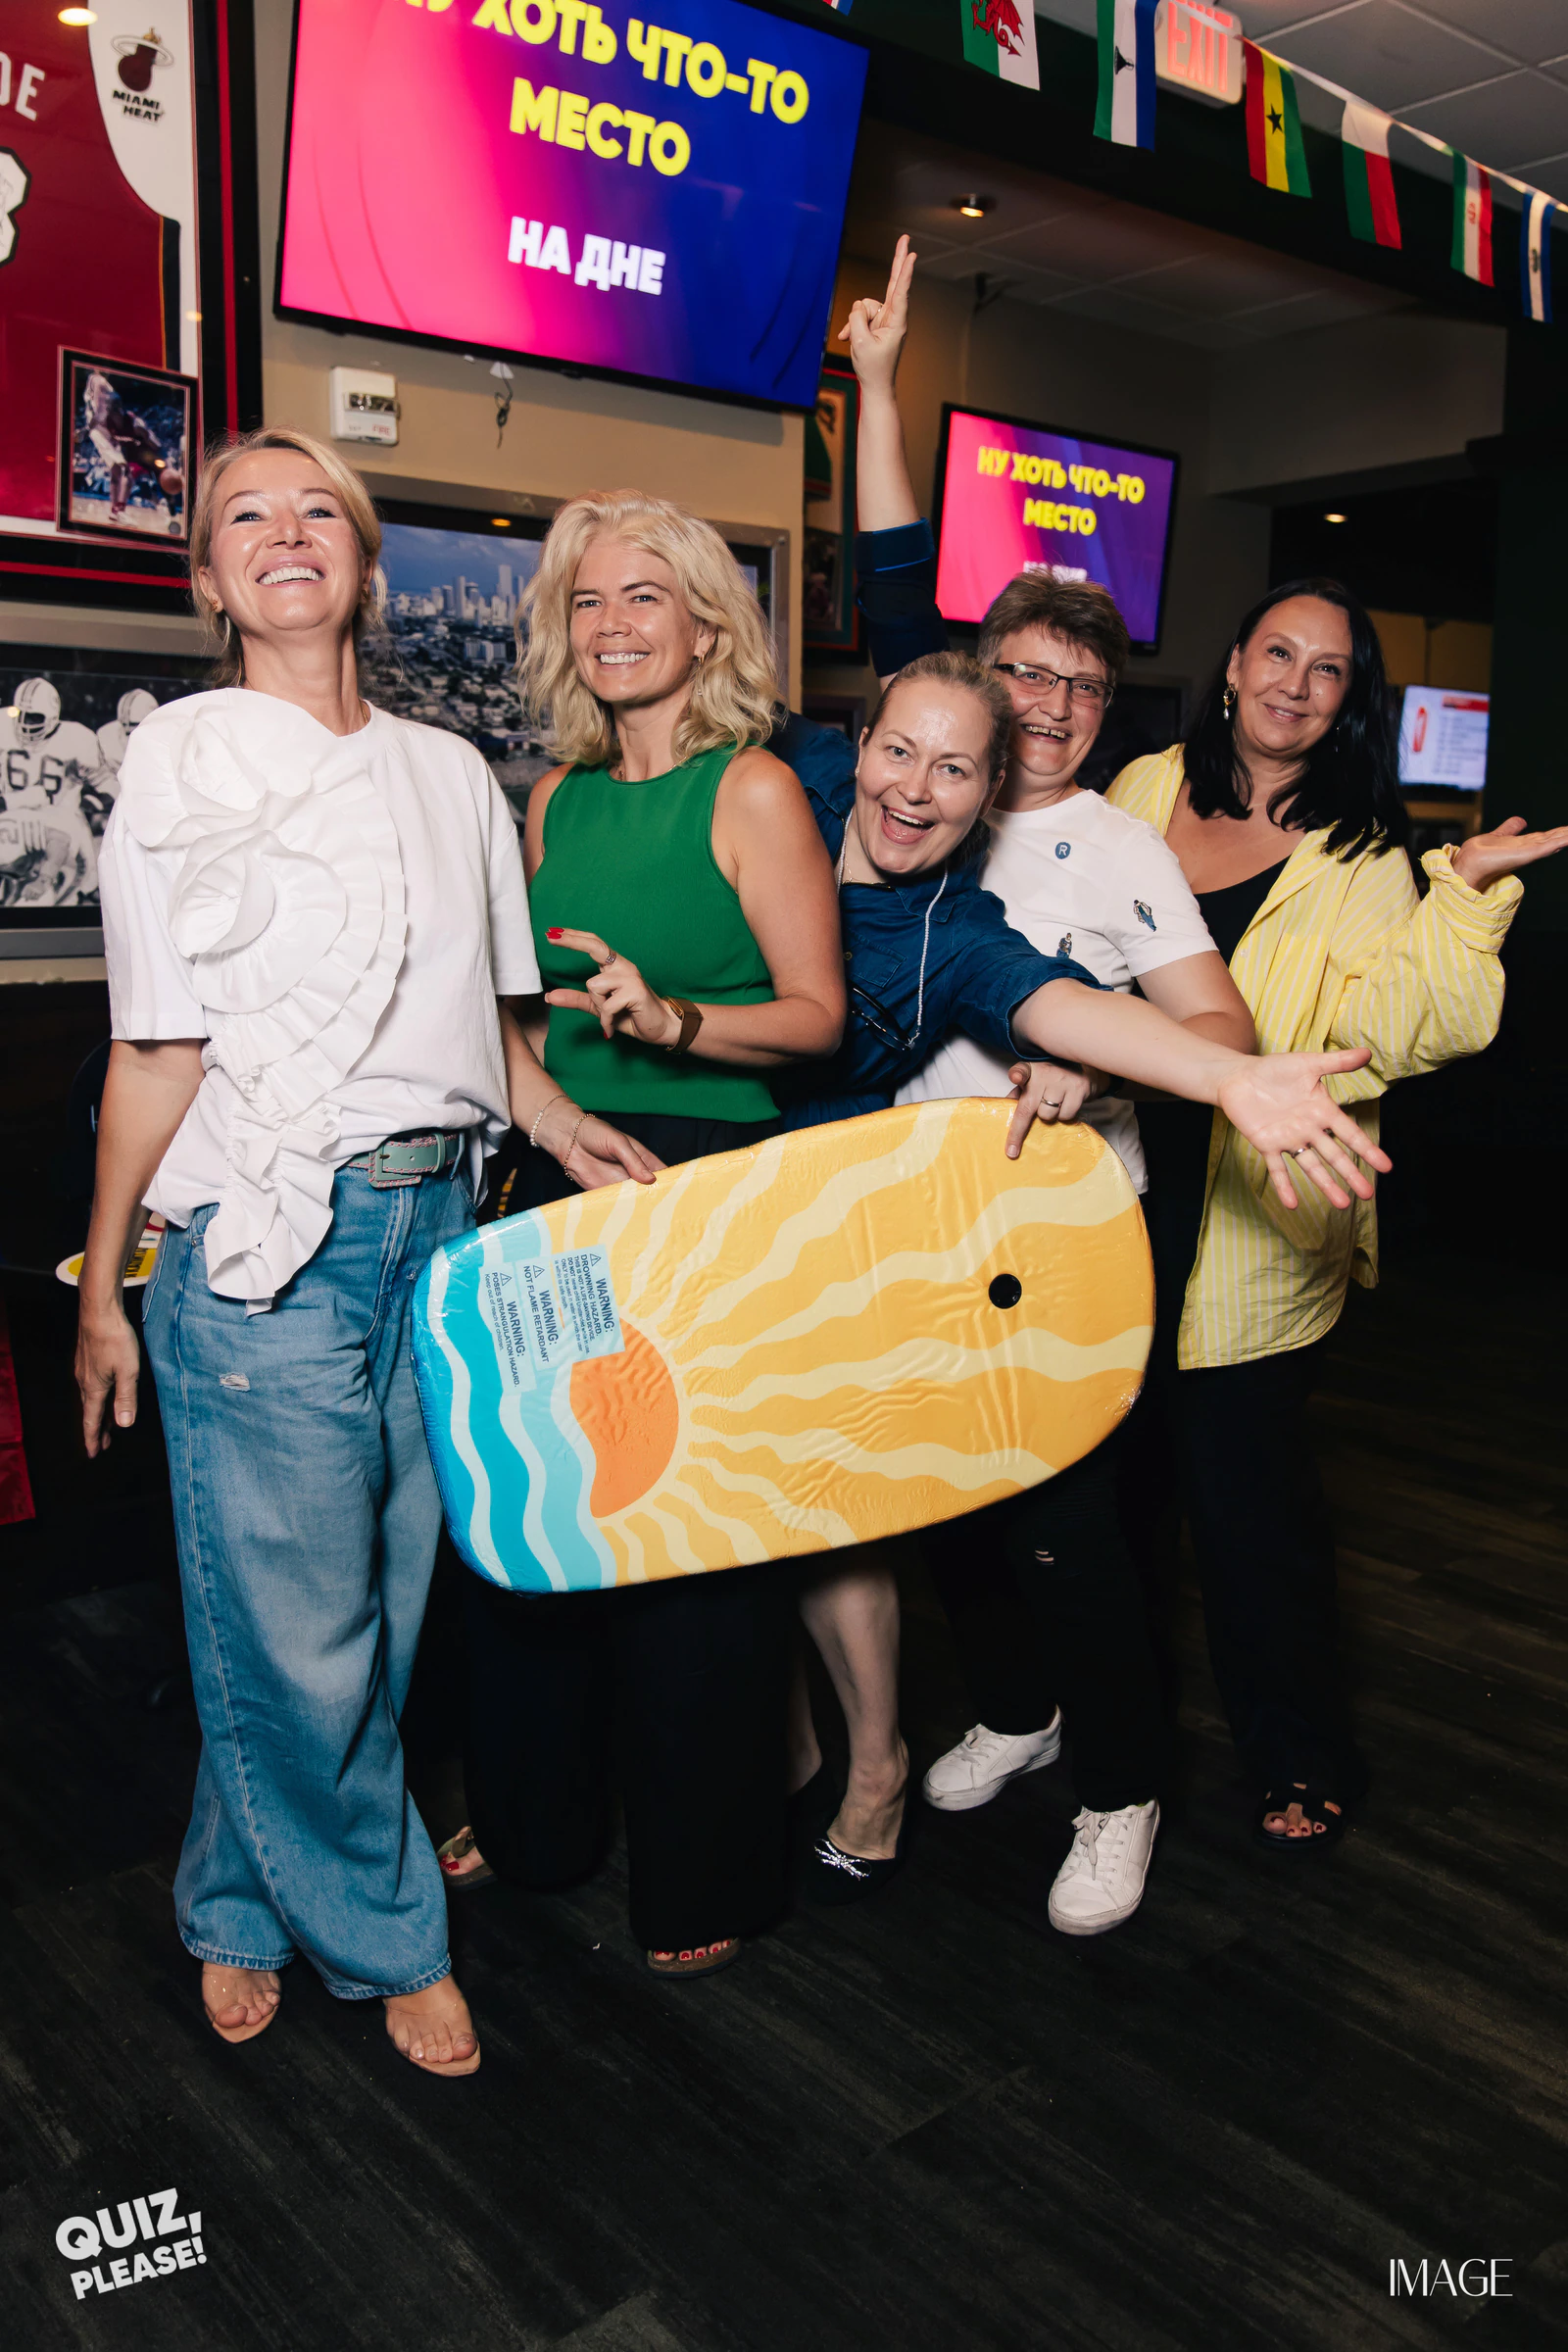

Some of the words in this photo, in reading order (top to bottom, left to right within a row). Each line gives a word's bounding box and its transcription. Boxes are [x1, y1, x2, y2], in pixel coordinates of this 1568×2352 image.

[472, 0, 617, 65] ХОТЬ
[627, 19, 809, 123] ЧТО-ТО
[1166, 0, 1234, 93] EXIT
[113, 90, 160, 110] MIAMI
[123, 105, 161, 122] HEAT
[510, 76, 691, 176] МЕСТО
[508, 217, 571, 274] НА
[574, 234, 665, 295] ДНЕ
[977, 445, 1009, 476] НУ
[1010, 452, 1067, 489] ХОТЬ
[1069, 464, 1146, 504] ЧТО-ТО
[1023, 498, 1097, 536] МЕСТО
[1058, 844, 1068, 857] R
[491, 1271, 502, 1296] POSES
[522, 1265, 532, 1283] NOT
[566, 1256, 573, 1265] DO
[526, 1284, 538, 1312] FLAME
[538, 1290, 560, 1345] WARNING:
[580, 1253, 595, 1299] DROWNING
[589, 1301, 602, 1336] HAZARD.
[580, 1290, 590, 1320] LIFE-SAVING
[595, 1278, 615, 1332] WARNING:
[496, 1297, 514, 1355] STRANGULATION
[506, 1300, 526, 1356] WARNING:
[532, 1314, 549, 1363] RETARDANT
[508, 1356, 519, 1387] HAZARD.
